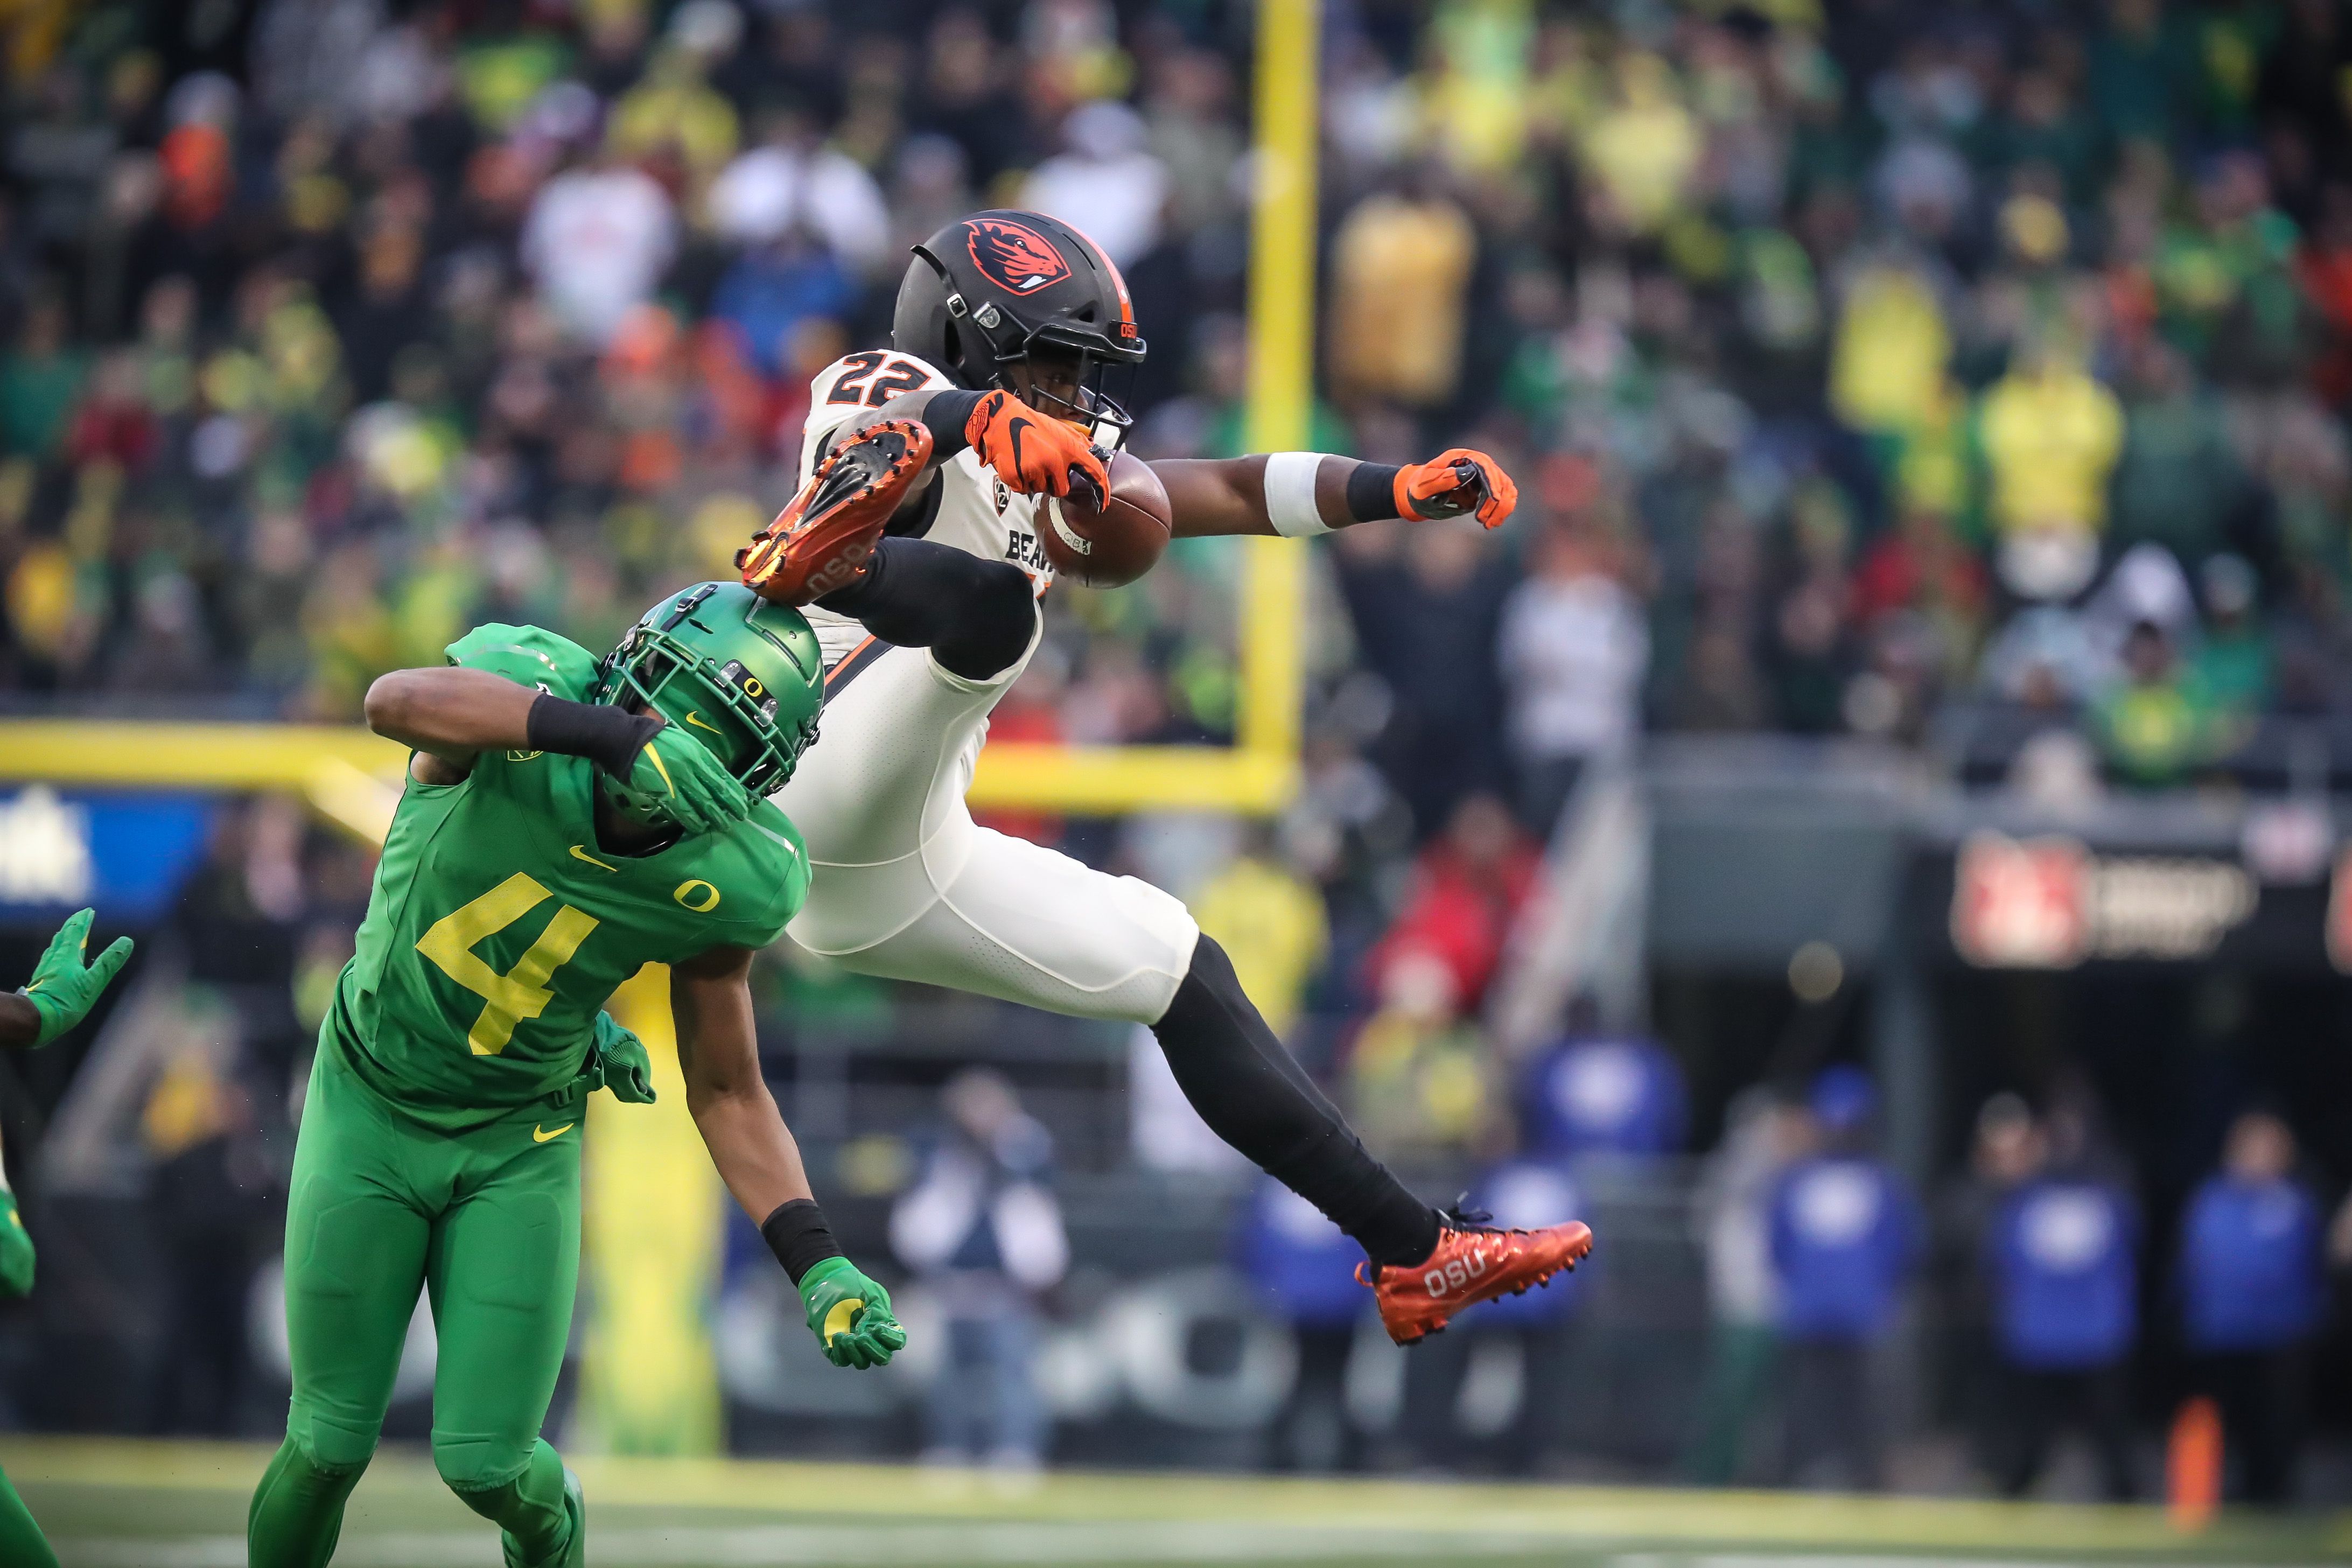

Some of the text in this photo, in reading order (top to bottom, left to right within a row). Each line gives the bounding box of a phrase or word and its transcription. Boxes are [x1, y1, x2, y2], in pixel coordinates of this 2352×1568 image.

[826, 351, 932, 409] 22
[807, 543, 866, 594] OSU
[744, 677, 763, 697] O
[673, 879, 720, 912] O
[414, 871, 600, 1055] 4
[1424, 1248, 1486, 1298] OSU
